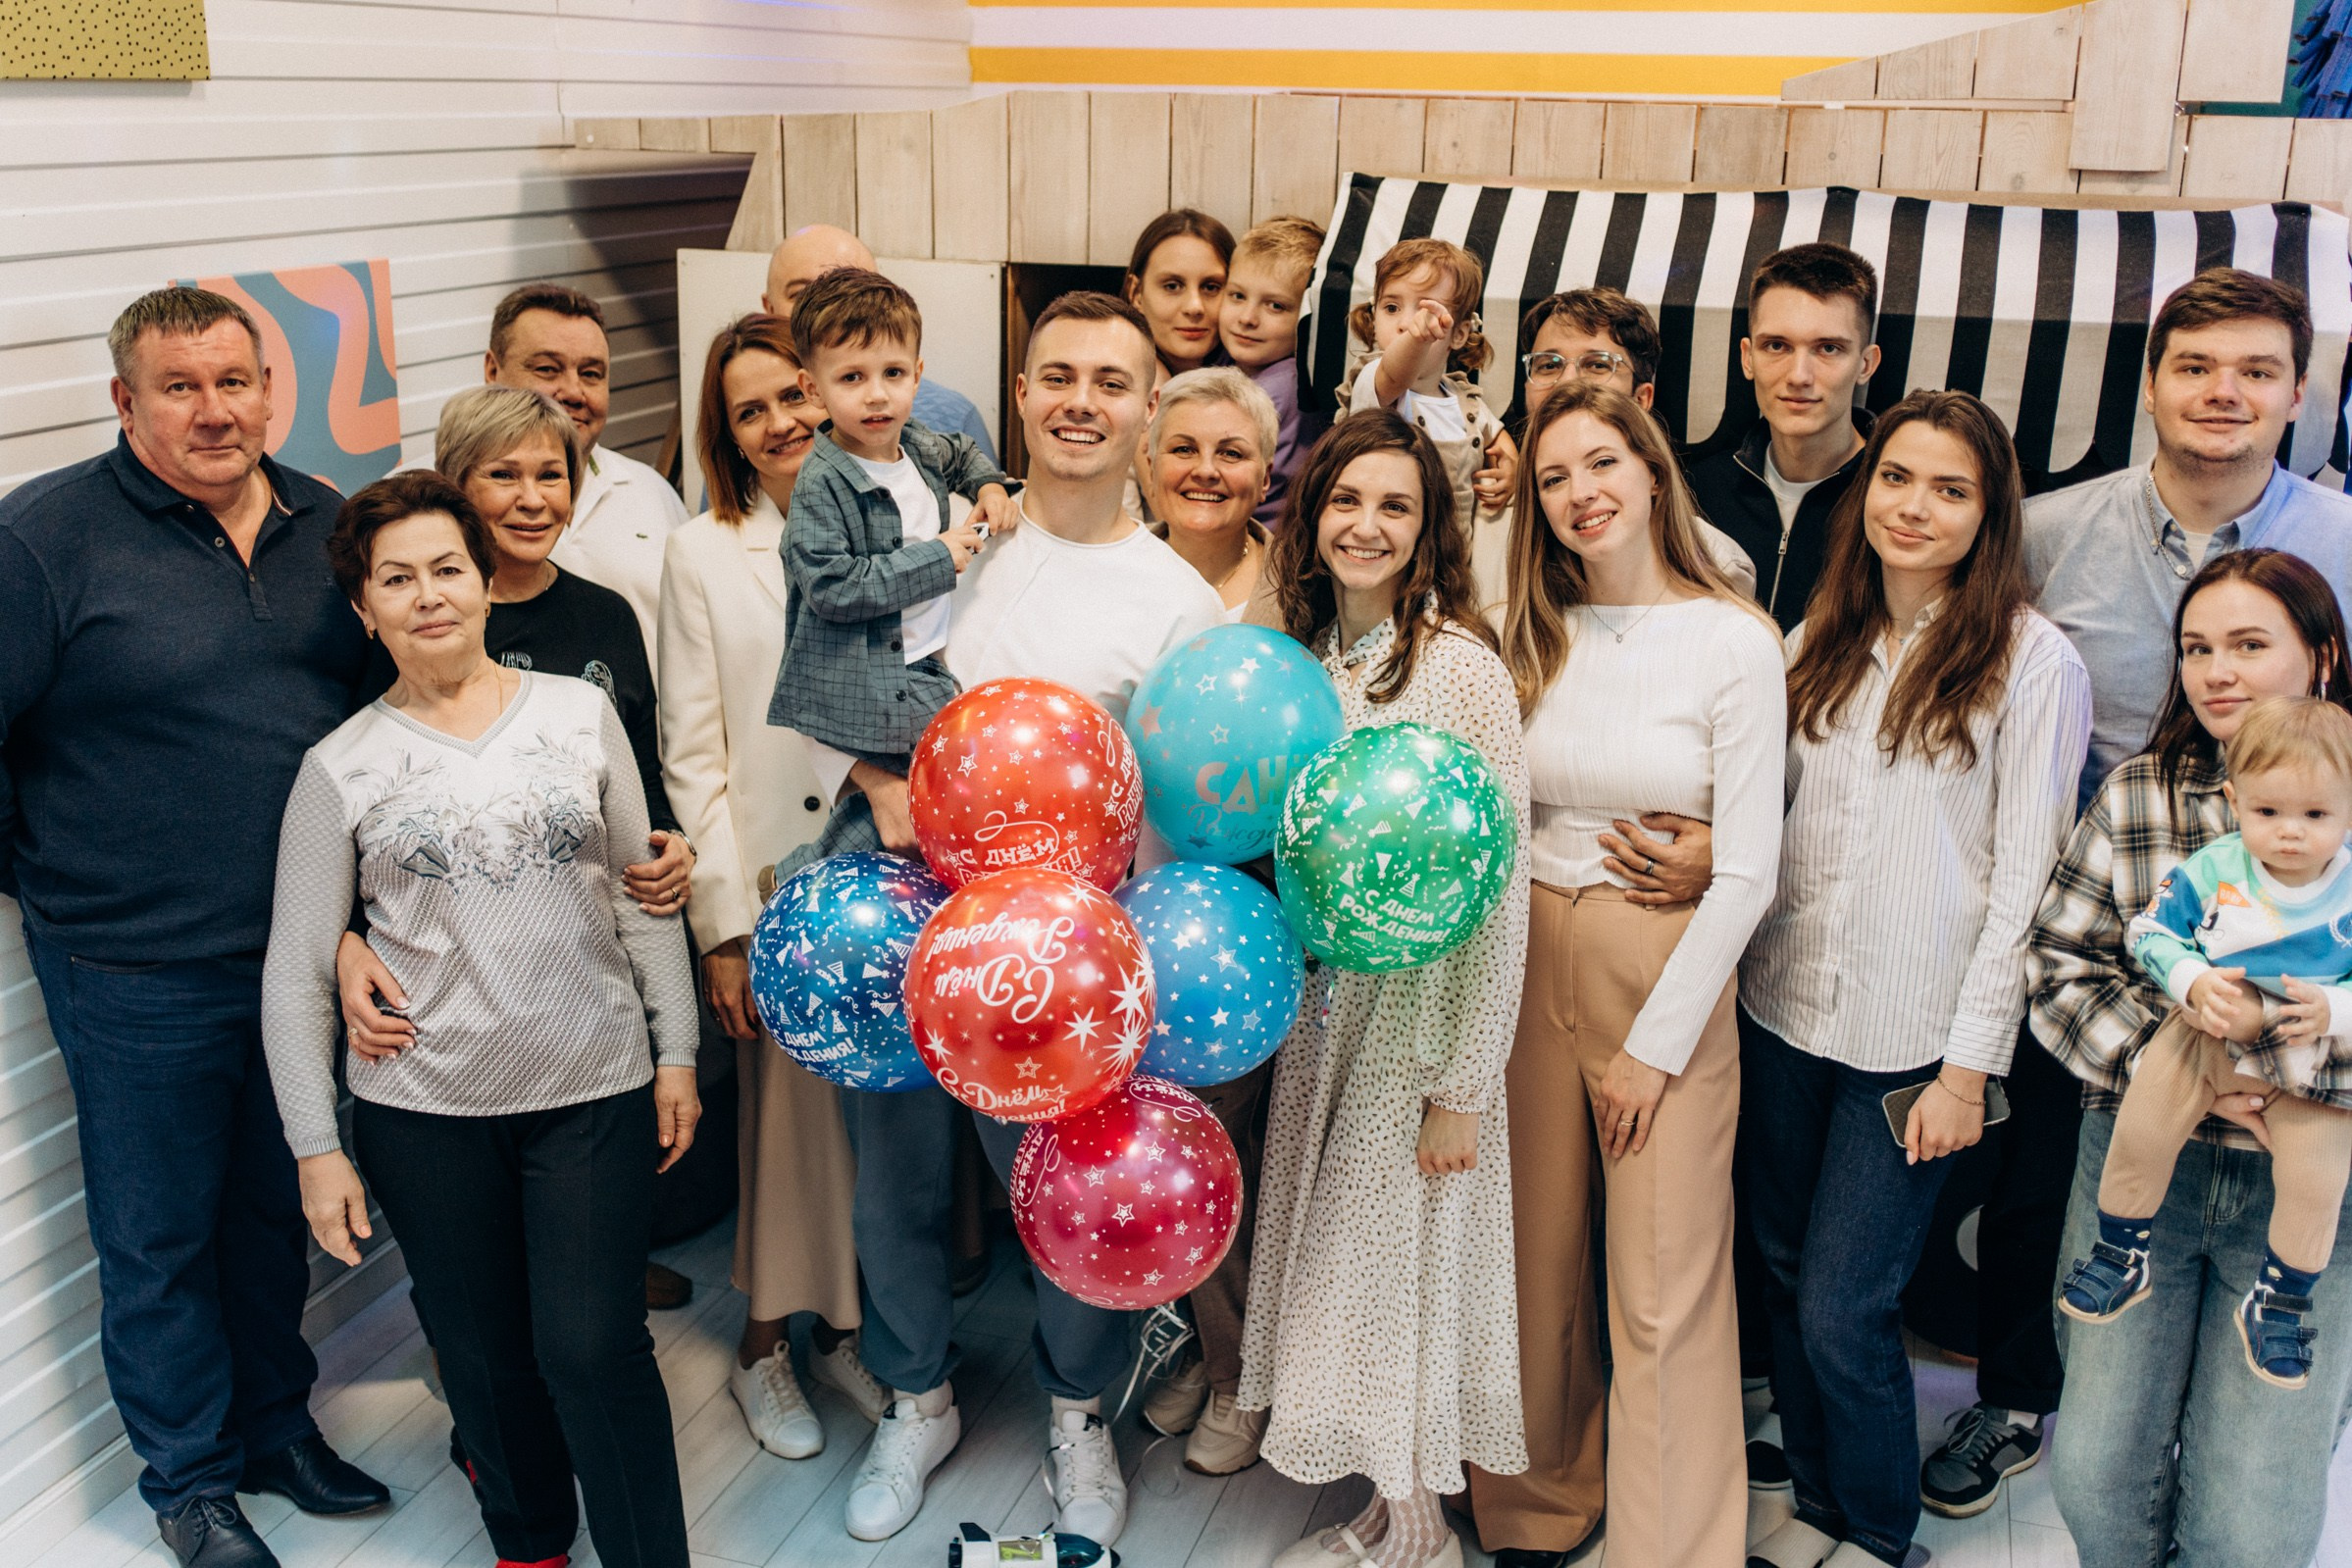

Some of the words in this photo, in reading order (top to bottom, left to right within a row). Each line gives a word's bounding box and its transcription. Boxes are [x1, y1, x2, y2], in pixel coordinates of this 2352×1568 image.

[960, 848, 978, 865] С
[984, 837, 1056, 867] ДНЁМ
[1339, 893, 1453, 943] РОЖДЕНИЯ!
[1364, 889, 1380, 905] С
[1378, 899, 1435, 927] ДНЕМ
[925, 912, 1075, 964] Рождения!
[935, 953, 1027, 1007] Днём
[1011, 965, 1054, 1024] С
[784, 1031, 827, 1047] ДНЕМ
[961, 1082, 1044, 1110] Днём
